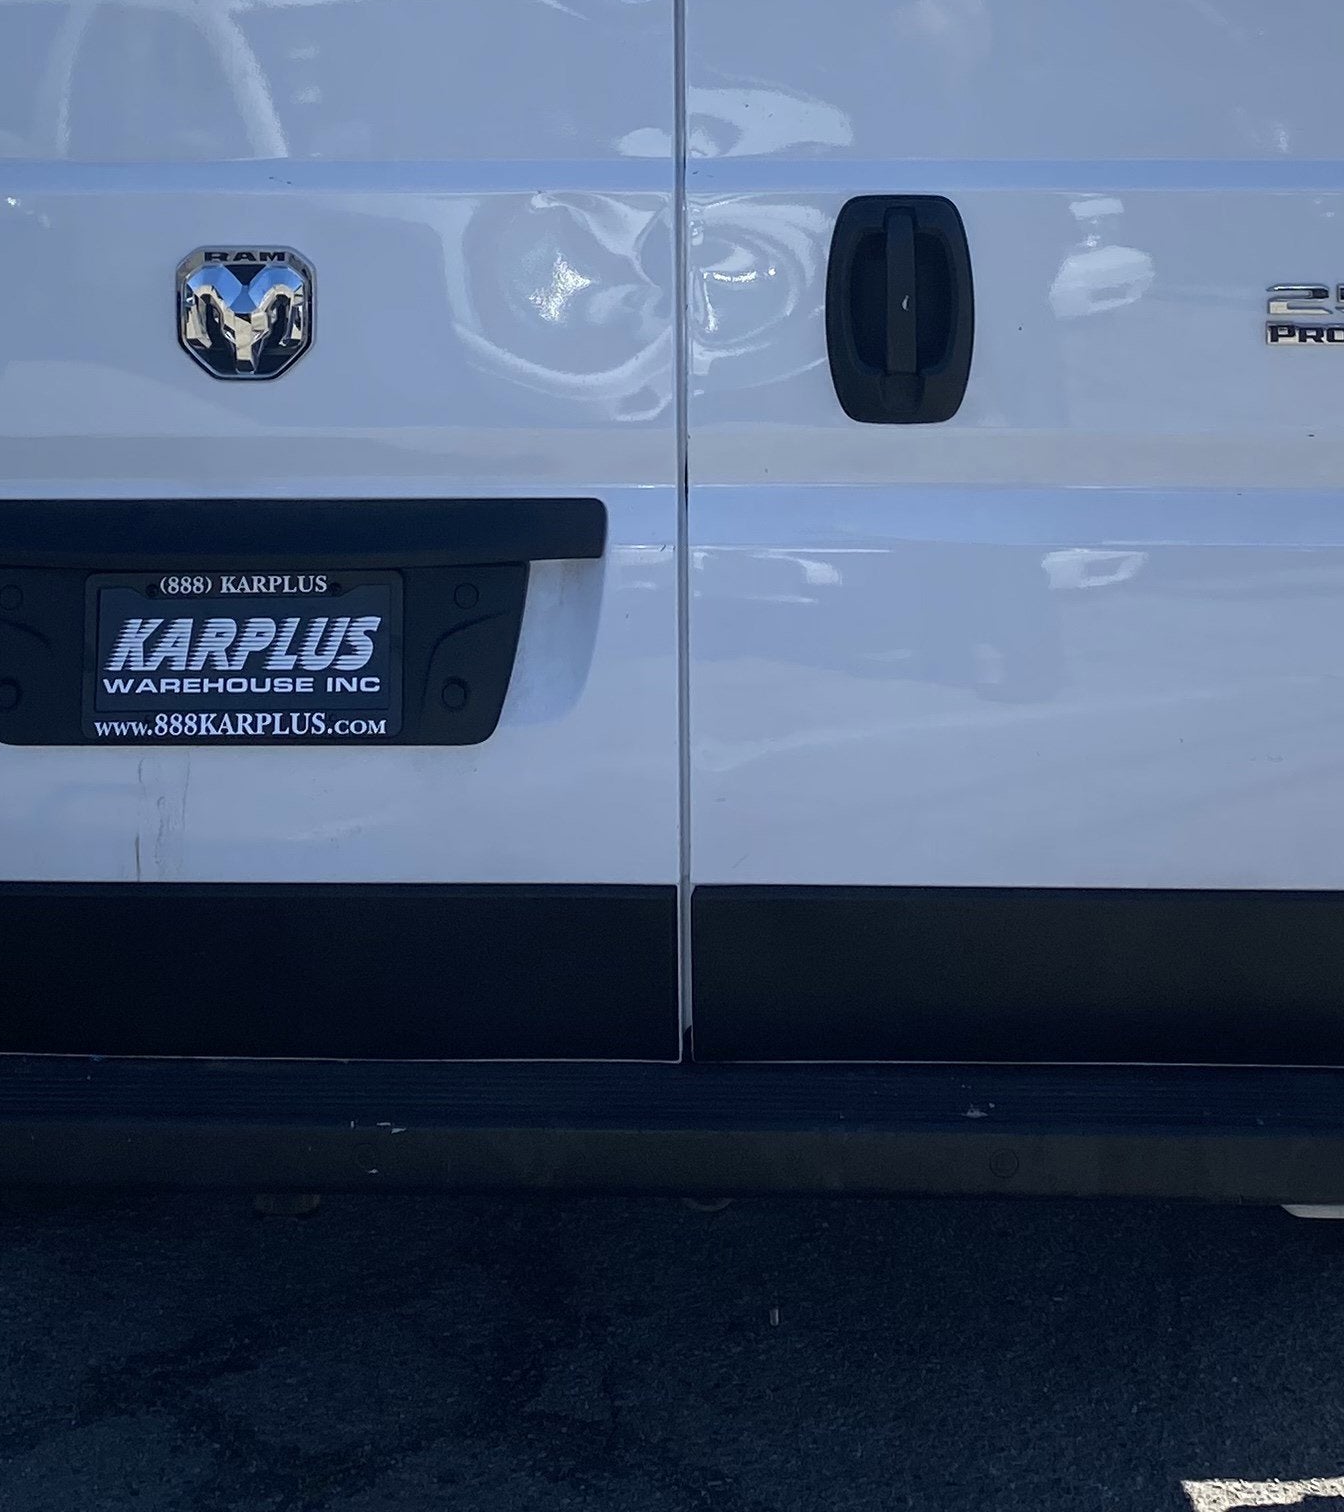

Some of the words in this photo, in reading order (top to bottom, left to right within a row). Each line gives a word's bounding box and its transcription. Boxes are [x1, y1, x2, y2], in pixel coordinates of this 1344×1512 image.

[204, 251, 286, 262] RAM
[159, 575, 213, 595] (888)
[220, 575, 328, 594] KARPLUS
[103, 616, 382, 672] KARPLUS
[103, 677, 314, 694] WAREHOUSE
[326, 677, 381, 693] INC
